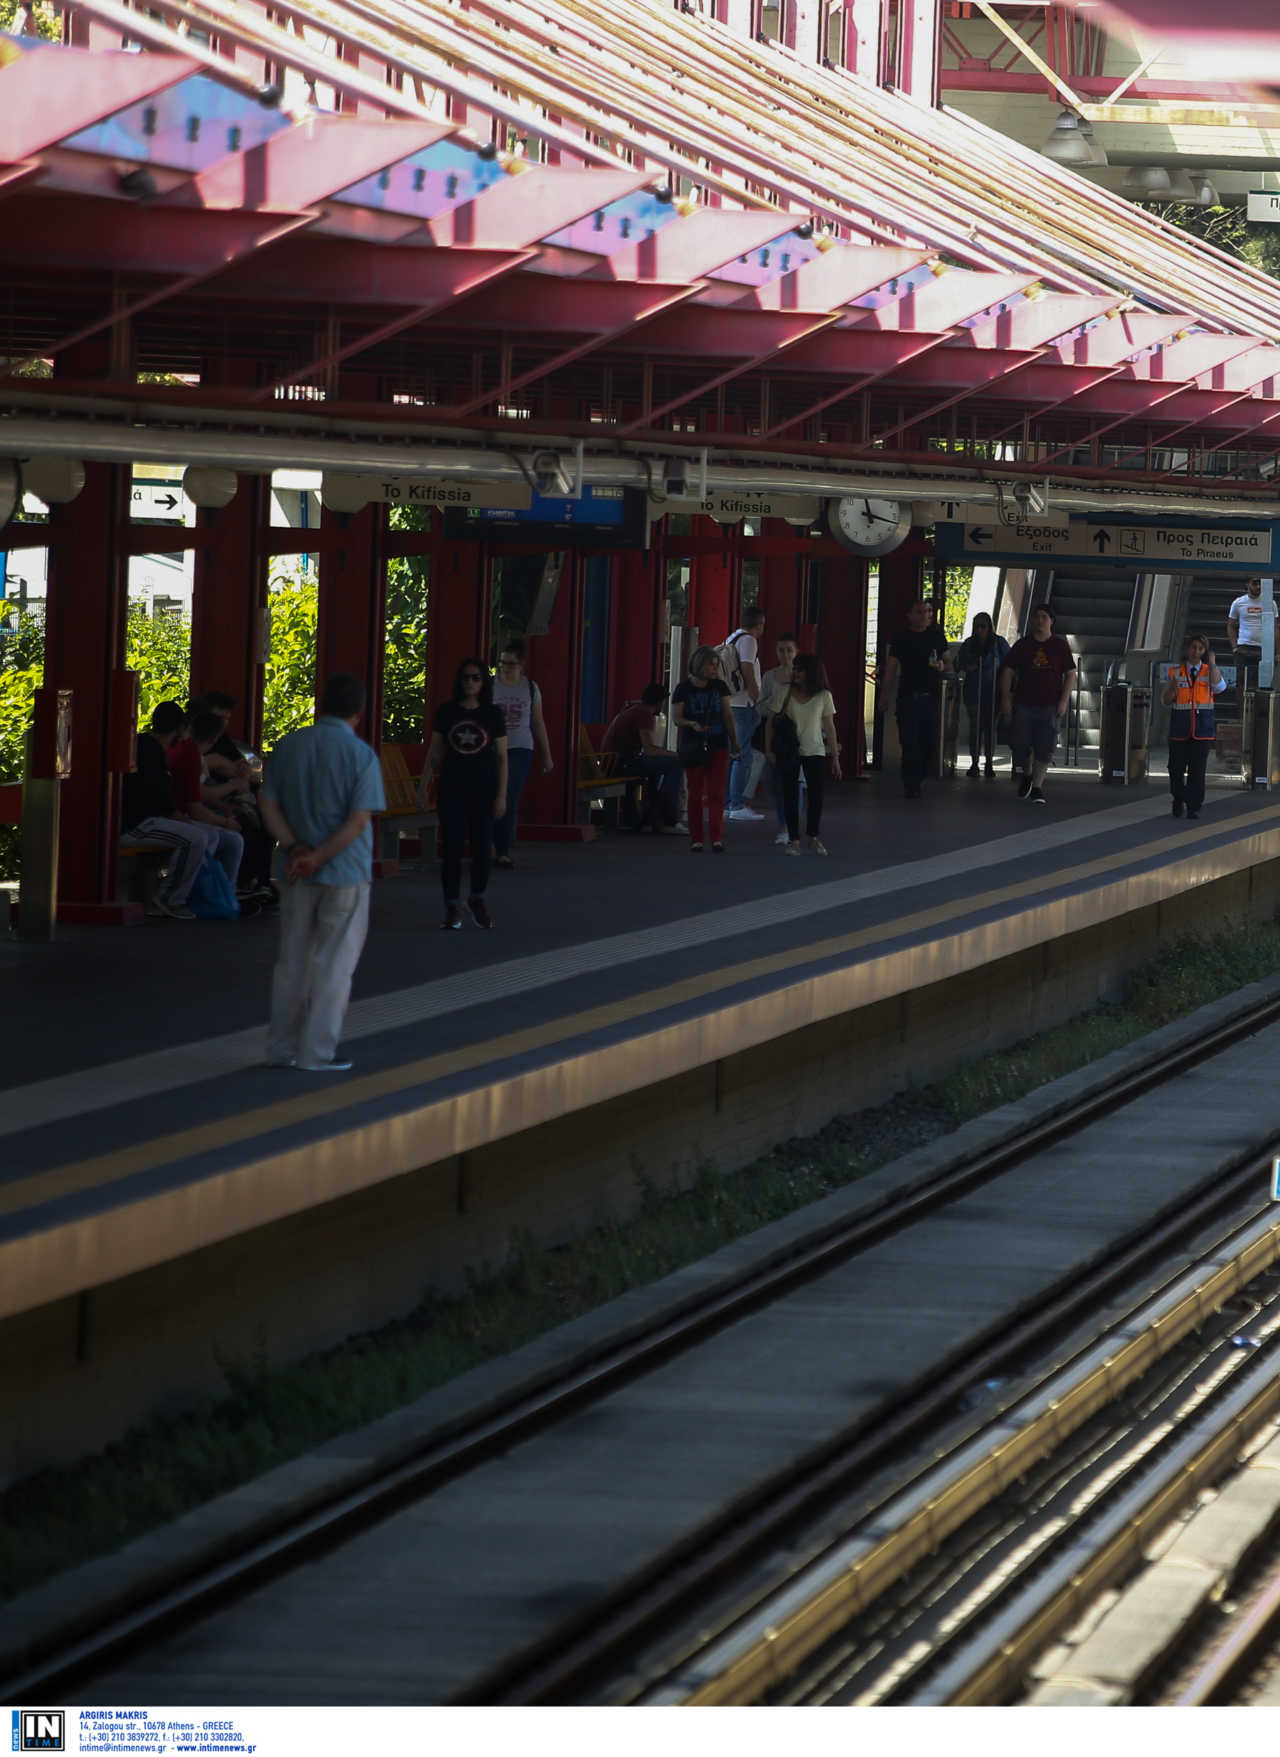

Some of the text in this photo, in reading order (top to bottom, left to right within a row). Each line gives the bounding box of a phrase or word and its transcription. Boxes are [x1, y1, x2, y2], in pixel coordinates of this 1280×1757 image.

[382, 483, 472, 502] To Kifissia
[720, 499, 772, 513] Kifissia
[1156, 530, 1259, 548] Προς Πειραιά
[1032, 543, 1053, 552] Exit
[1180, 548, 1235, 559] To Piraeus
